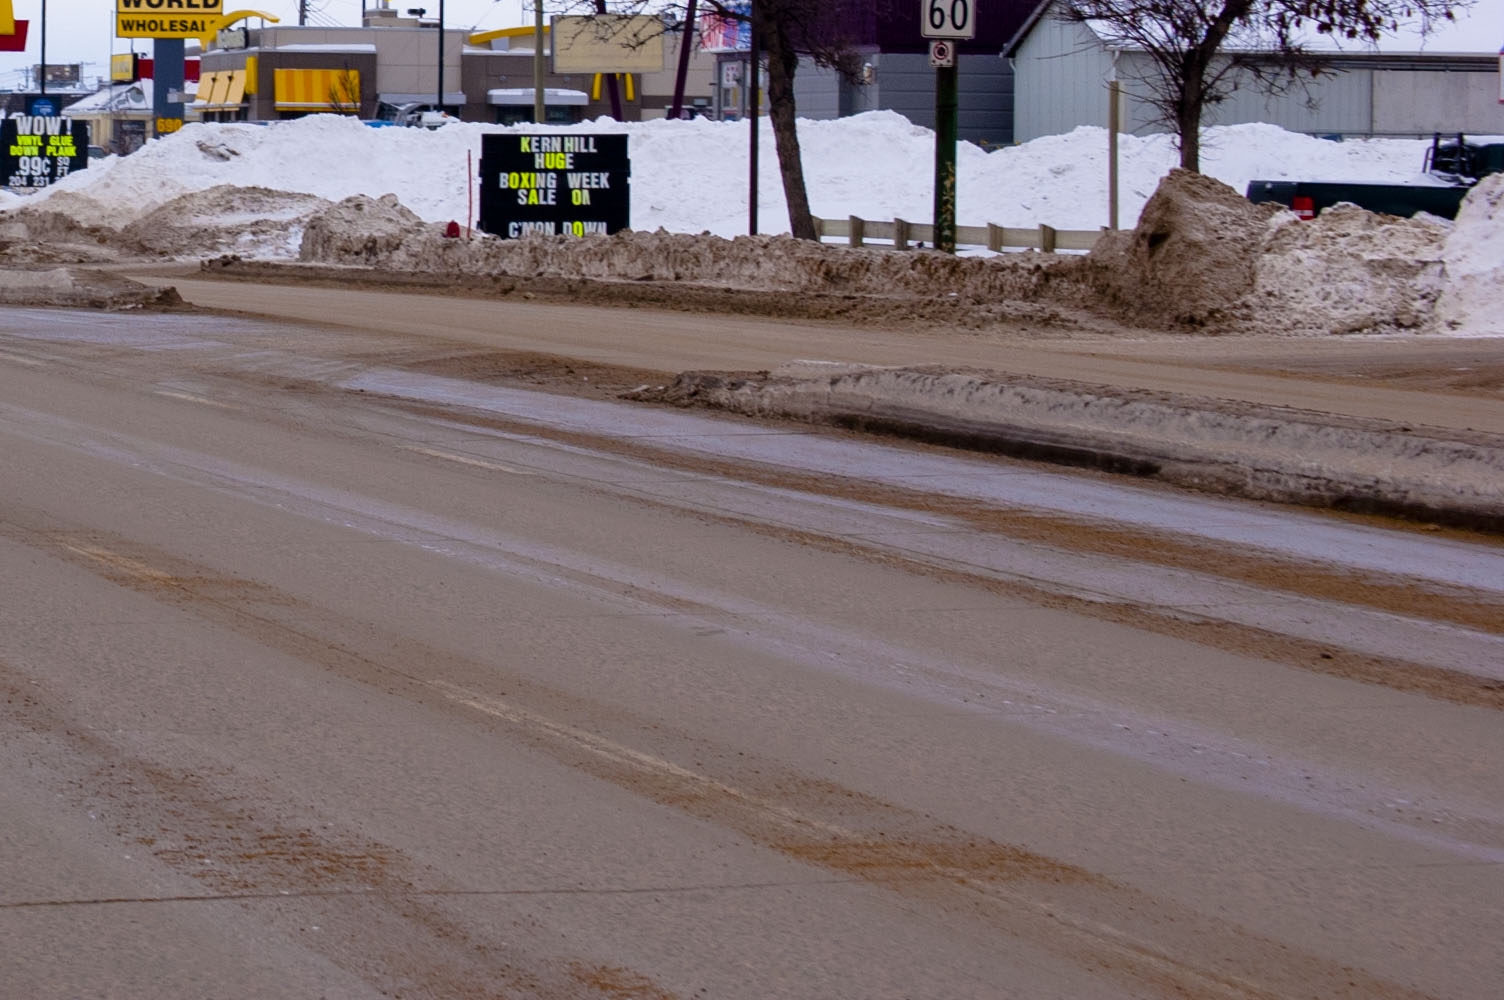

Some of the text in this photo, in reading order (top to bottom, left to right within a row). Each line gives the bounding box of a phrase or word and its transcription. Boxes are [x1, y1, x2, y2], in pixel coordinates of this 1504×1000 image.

[121, 20, 215, 32] WHOLESAL
[17, 135, 74, 146] VINYL GLUE
[520, 136, 597, 152] KERN HILL
[10, 145, 77, 157] DOWN PLANK
[57, 156, 70, 166] SQ
[535, 153, 574, 169] HUGE
[499, 172, 610, 188] BOXING WEEK
[517, 189, 557, 205] SALE
[508, 221, 607, 238] C'MON DOWN
